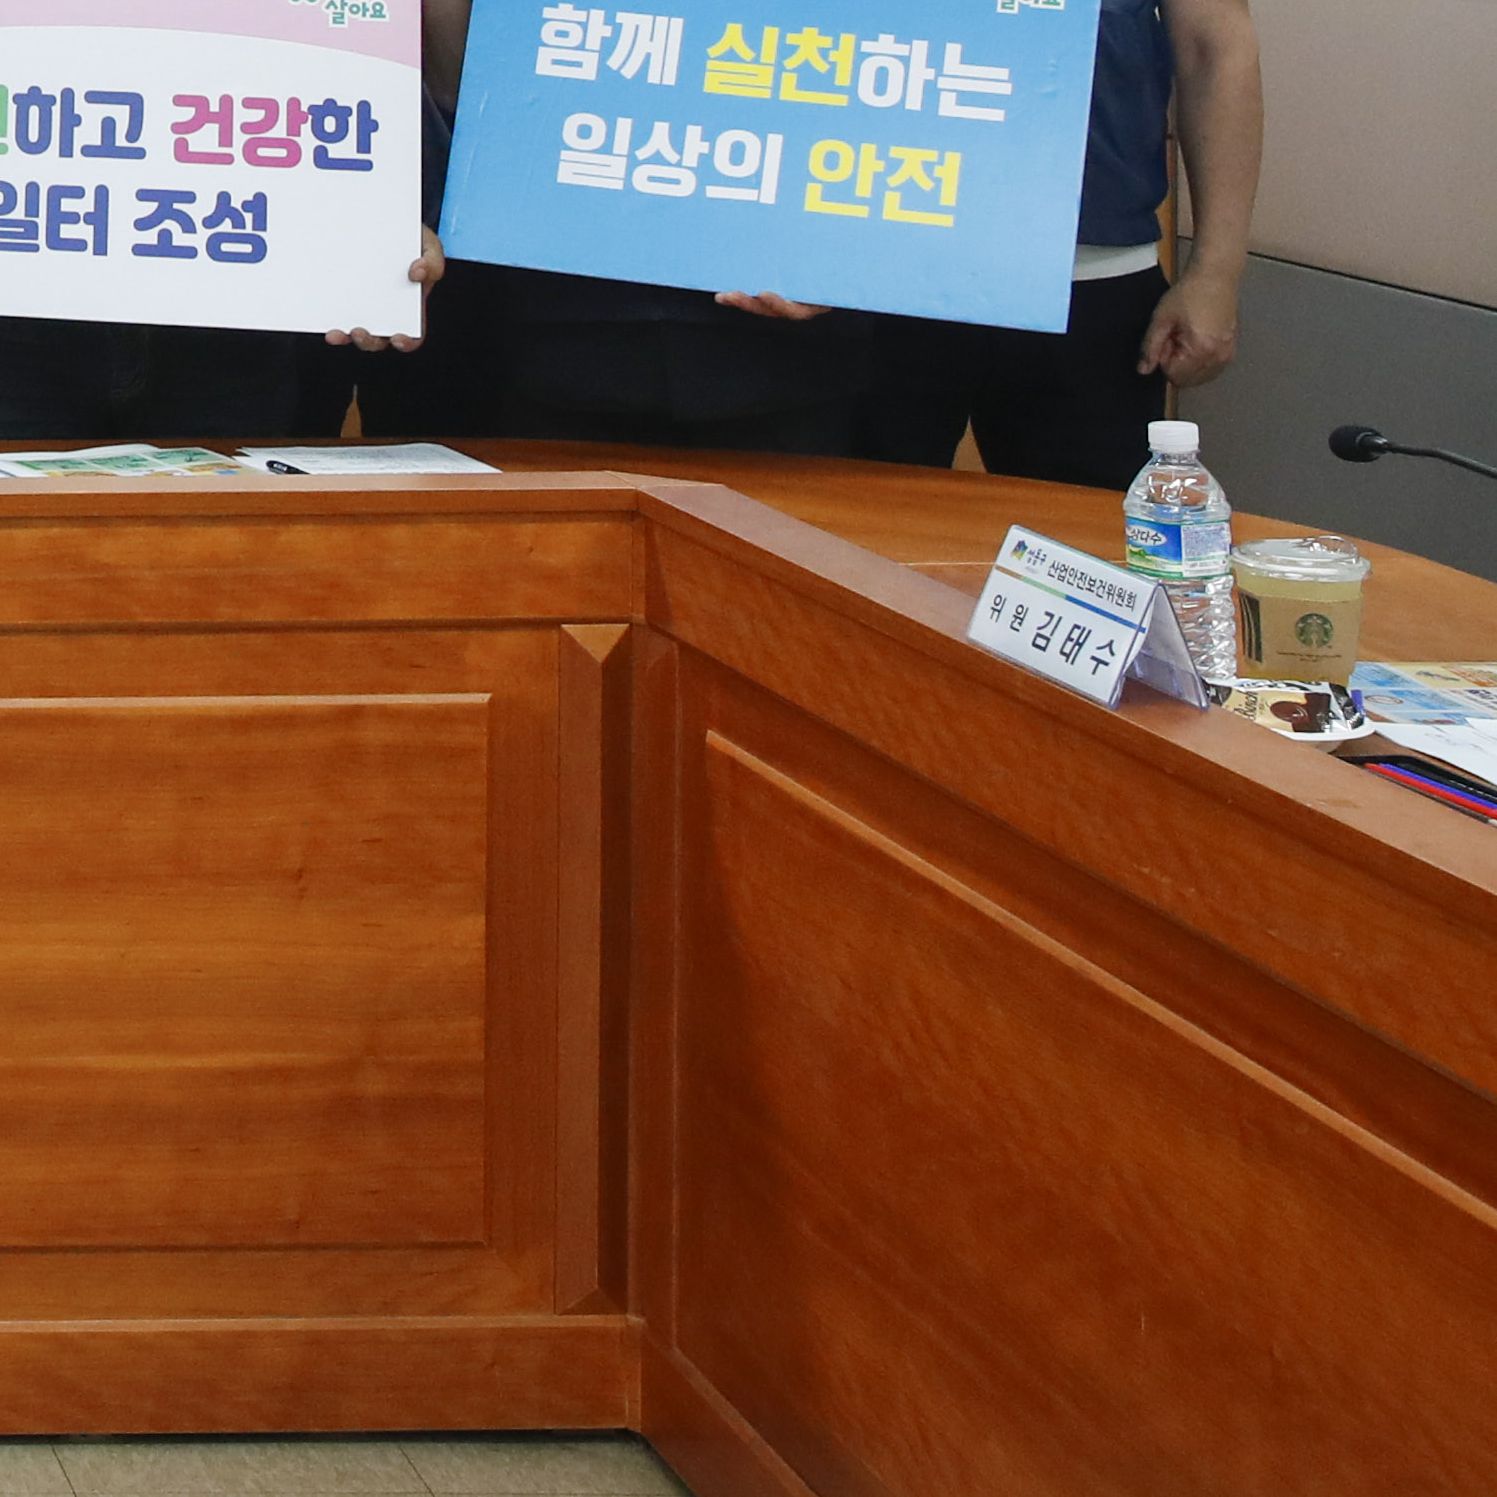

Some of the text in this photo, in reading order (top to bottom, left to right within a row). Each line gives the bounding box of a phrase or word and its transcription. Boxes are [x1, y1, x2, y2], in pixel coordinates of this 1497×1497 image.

[534, 3, 1013, 122] 함께 실천하는
[170, 93, 379, 171] 건강한
[556, 112, 961, 228] 일상의 안전
[131, 187, 268, 263] 조성
[1026, 548, 1137, 612] 성동구 산업안전보건위원회
[990, 594, 1116, 676] 위원 김태수
